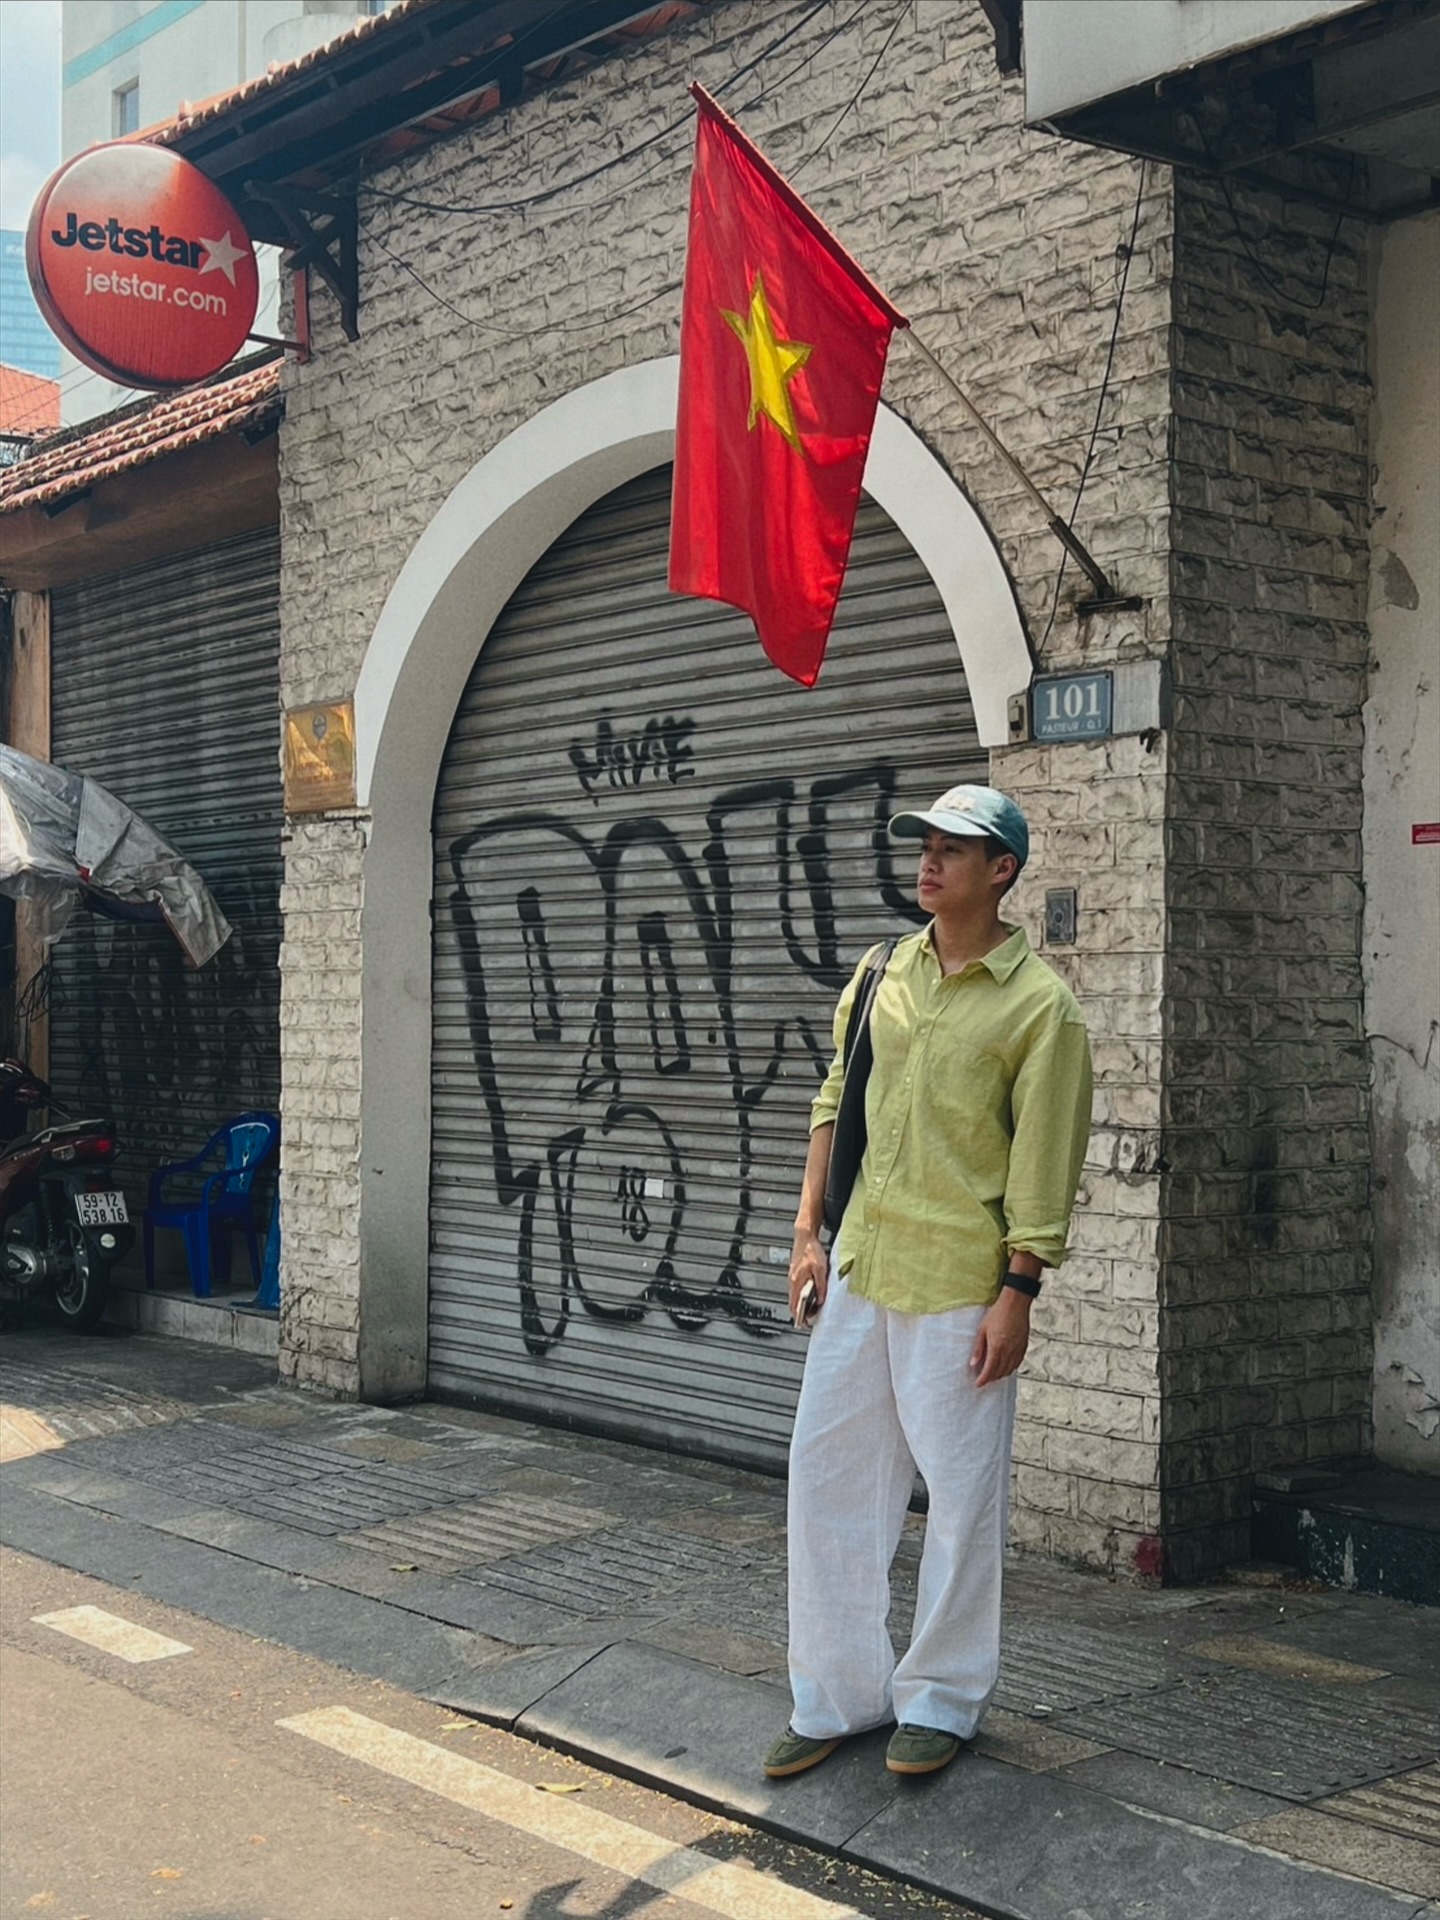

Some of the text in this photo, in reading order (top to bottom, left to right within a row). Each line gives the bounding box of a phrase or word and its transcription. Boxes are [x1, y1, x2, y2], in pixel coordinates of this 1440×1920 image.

[51, 212, 204, 269] Jetstar
[85, 266, 227, 316] jetstar.com
[1046, 682, 1101, 720] 101
[83, 1192, 119, 1208] 59-T2
[83, 1207, 125, 1224] 538.16
